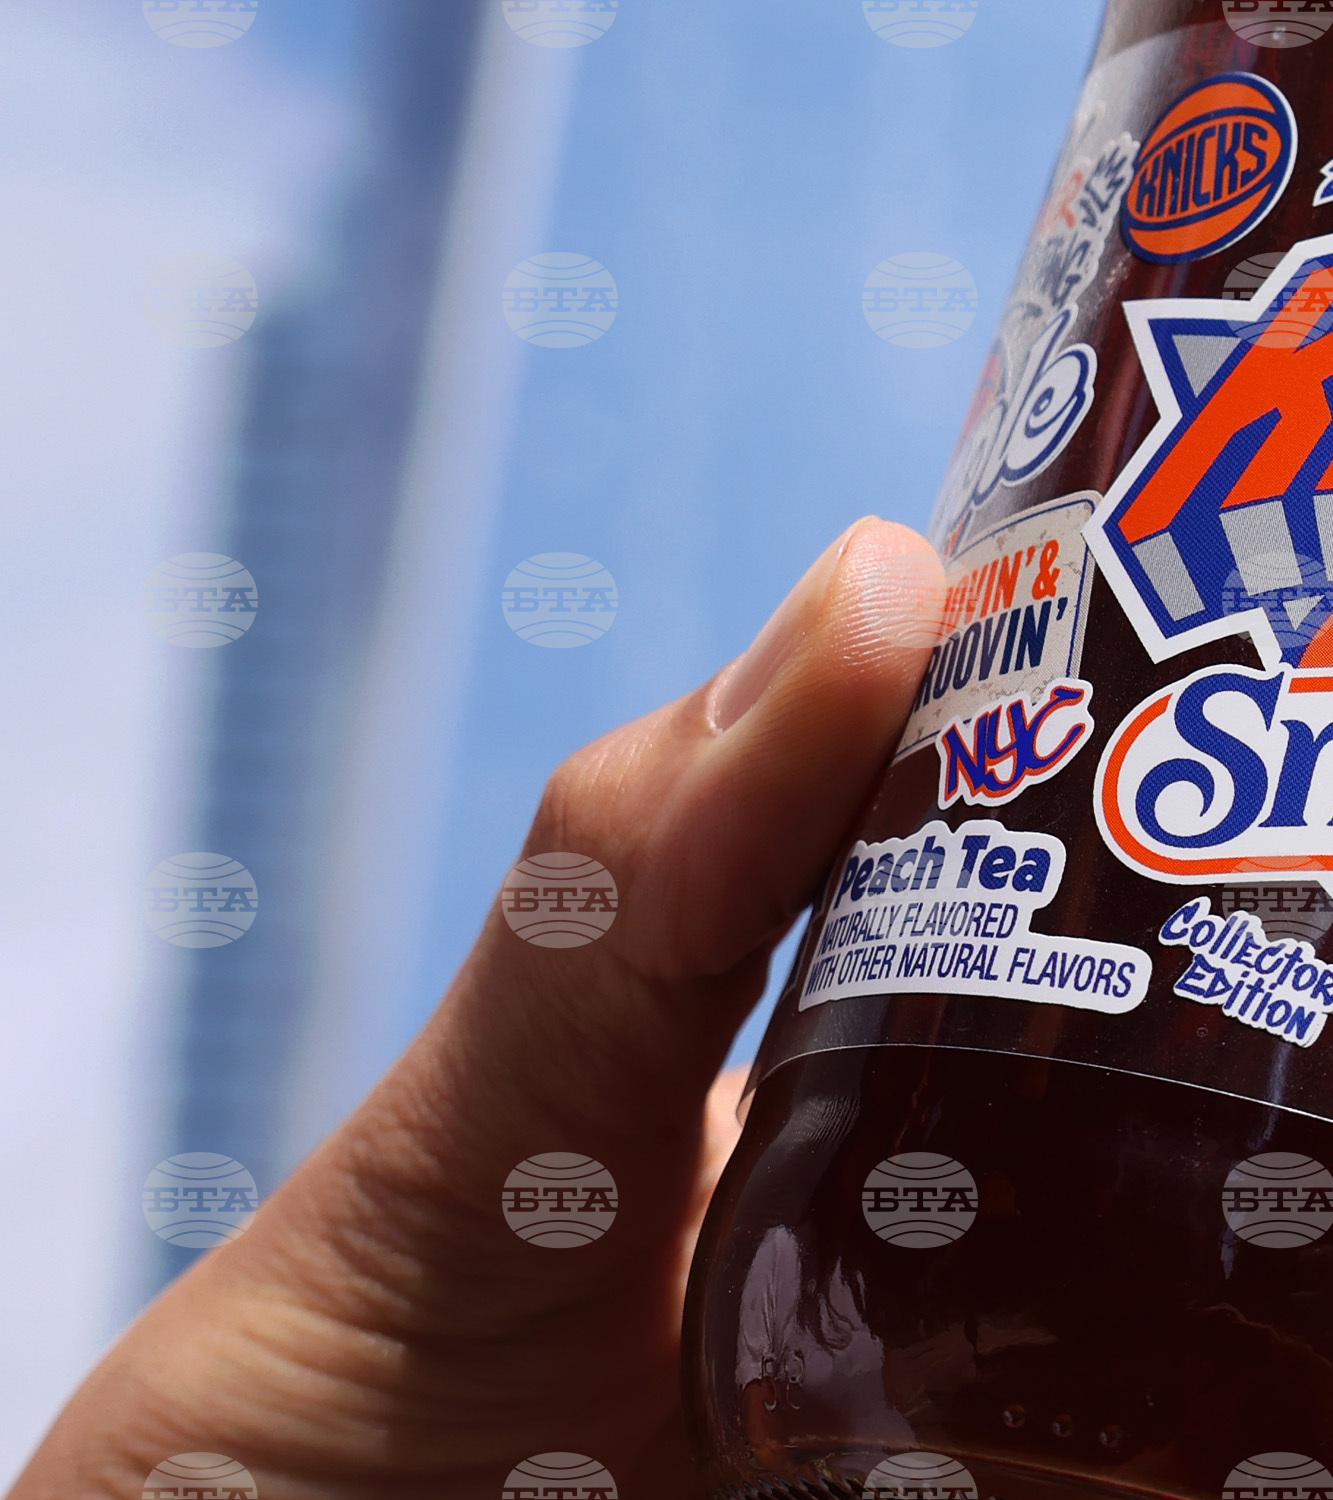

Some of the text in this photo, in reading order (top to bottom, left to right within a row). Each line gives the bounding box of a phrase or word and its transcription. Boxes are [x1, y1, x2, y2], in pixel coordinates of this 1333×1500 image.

[1134, 122, 1268, 217] KNICKS
[942, 540, 1060, 638] OVIN' &
[914, 597, 1067, 713] ROOVIN'
[945, 685, 1085, 801] NYC
[836, 835, 1052, 909] Peach Tea
[805, 946, 1135, 998] WITH OTHER NATURAL FLAVORS
[817, 902, 1017, 957] NATURALLY FLAVORED
